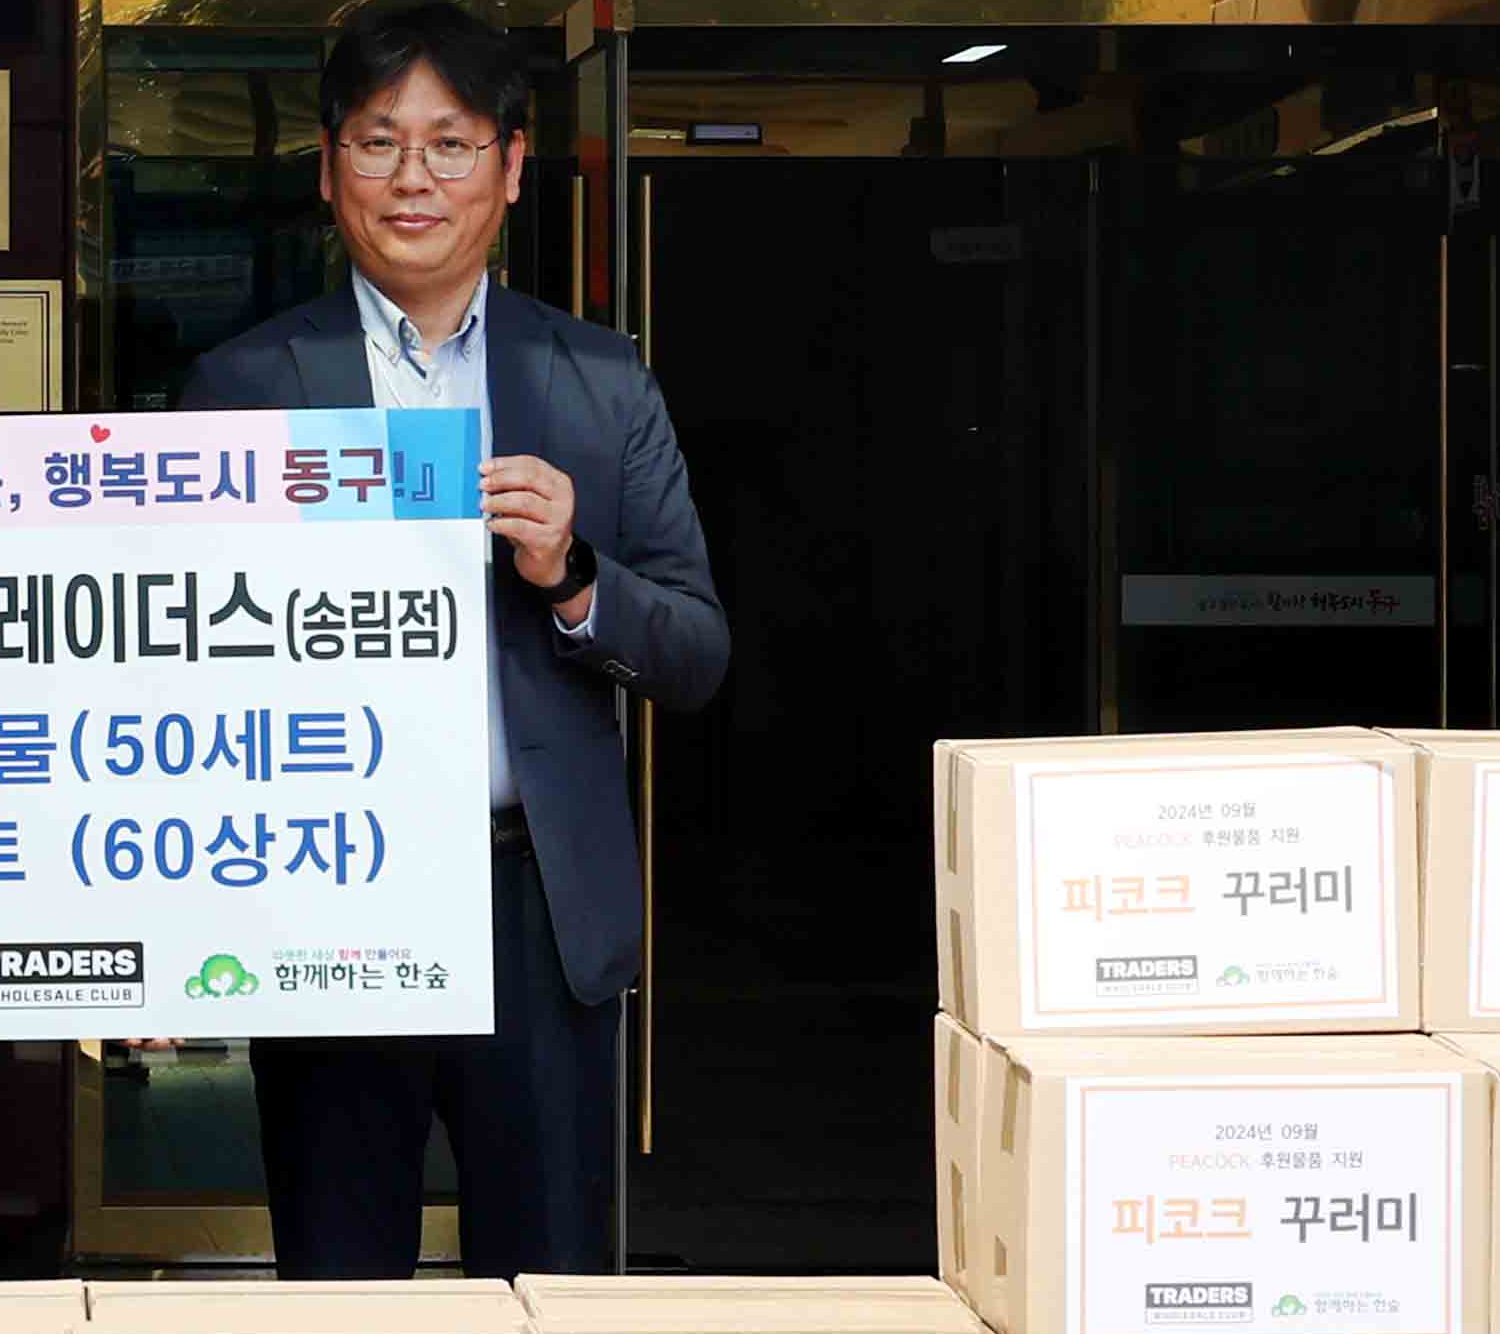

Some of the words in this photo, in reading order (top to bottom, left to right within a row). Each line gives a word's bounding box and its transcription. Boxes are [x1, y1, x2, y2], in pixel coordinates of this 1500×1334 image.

[44, 450, 257, 508] 행복도시
[71, 809, 385, 888] (60상자)
[1061, 874, 1196, 923] 피코크
[1222, 864, 1353, 916] 꾸러미
[89, 987, 135, 1002] CLUB
[274, 962, 386, 992] 함께하는
[394, 961, 450, 991] 한숲
